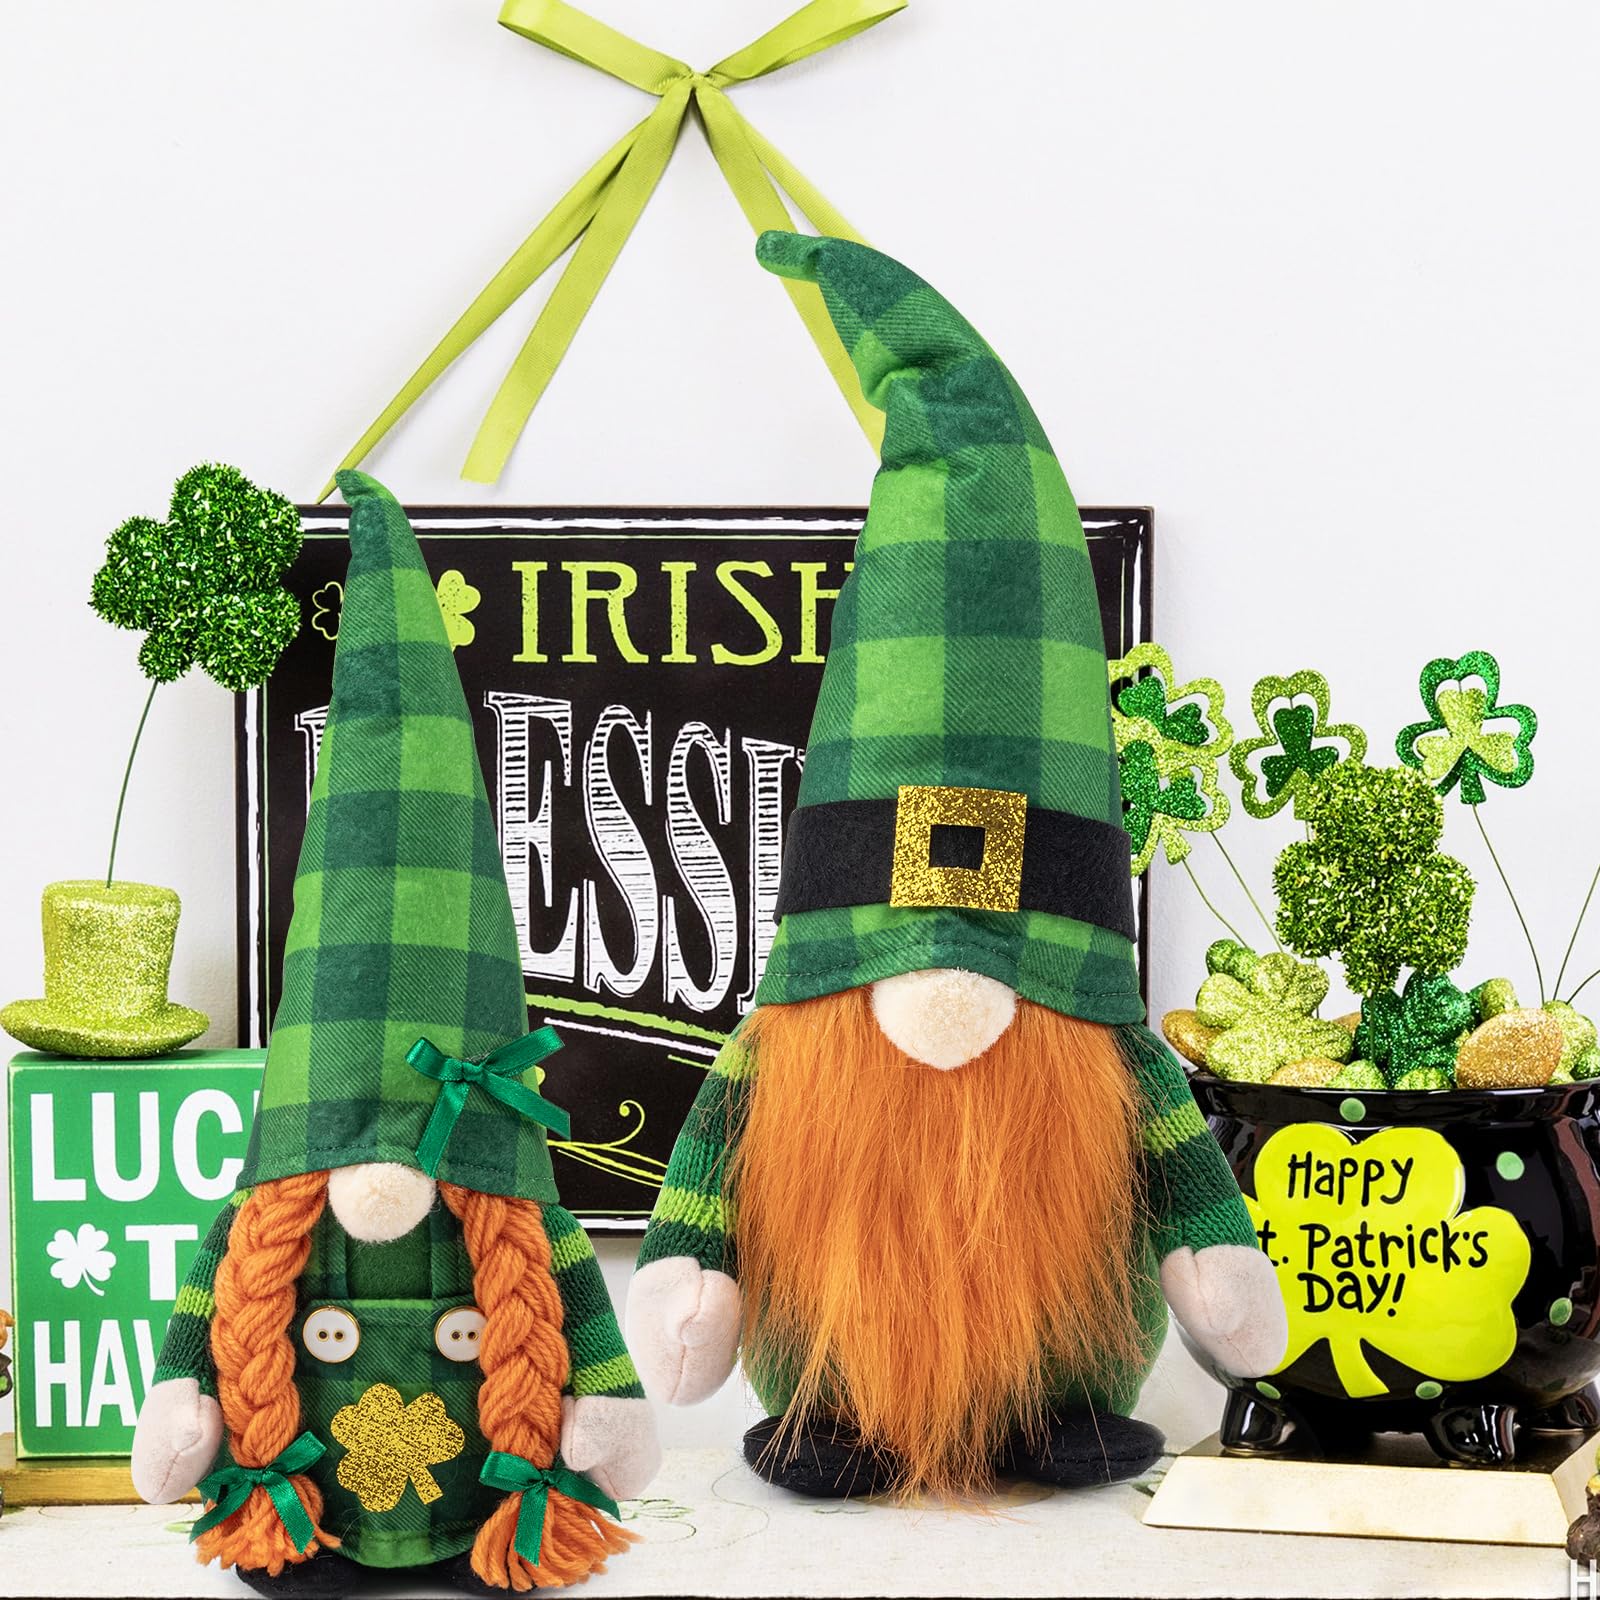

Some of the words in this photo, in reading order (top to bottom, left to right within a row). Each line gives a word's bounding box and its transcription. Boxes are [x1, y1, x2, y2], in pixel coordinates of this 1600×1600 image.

[511, 560, 855, 665] IRISH
[30, 1088, 260, 1202] LUC
[1287, 1151, 1414, 1207] Happy
[125, 1224, 199, 1301] T
[1256, 1219, 1289, 1267] t.
[1299, 1219, 1489, 1273] Patrick's
[1297, 1271, 1406, 1318] Day!
